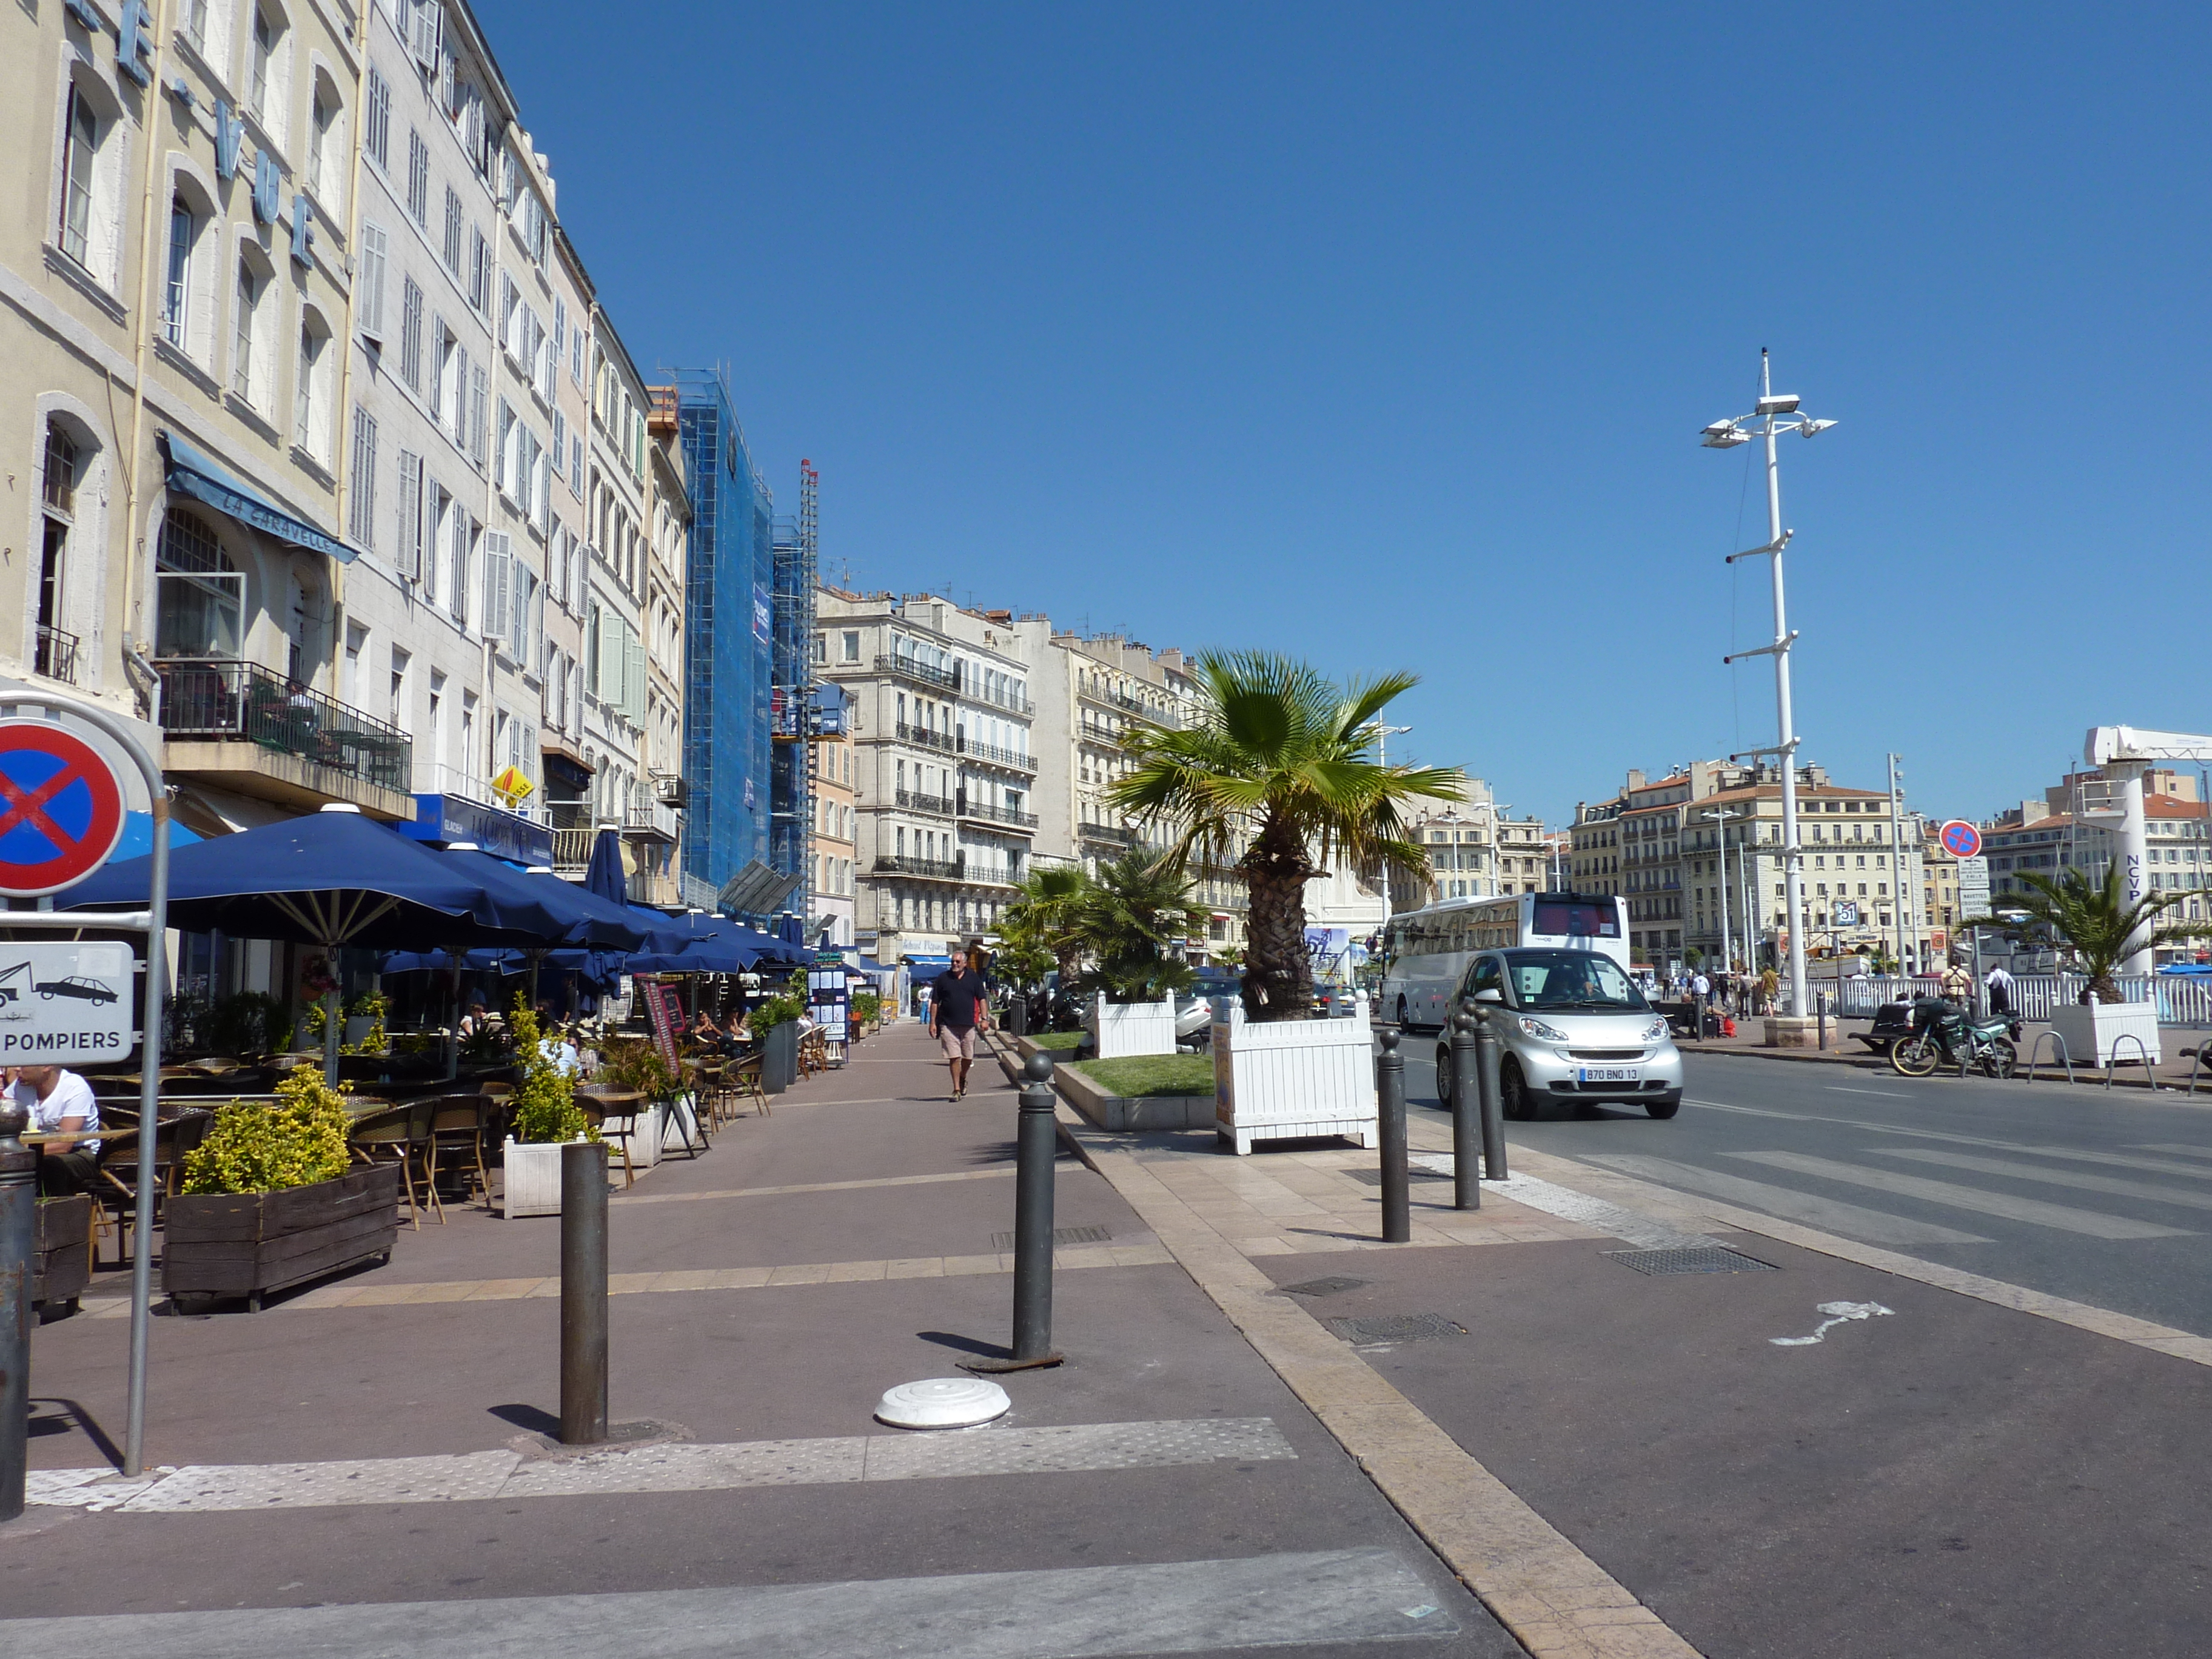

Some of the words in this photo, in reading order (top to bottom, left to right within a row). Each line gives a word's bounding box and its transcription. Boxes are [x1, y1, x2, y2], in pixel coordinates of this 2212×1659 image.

[222, 494, 243, 514] LA
[250, 508, 331, 552] CARAVELLE
[506, 783, 530, 805] PRESSE
[444, 818, 463, 835] GLACIER
[2127, 854, 2140, 901] NCVP
[1841, 908, 1853, 920] 51
[4, 1031, 120, 1051] POMPIERS
[1587, 1070, 1604, 1079] 870
[1627, 1070, 1637, 1079] 13
